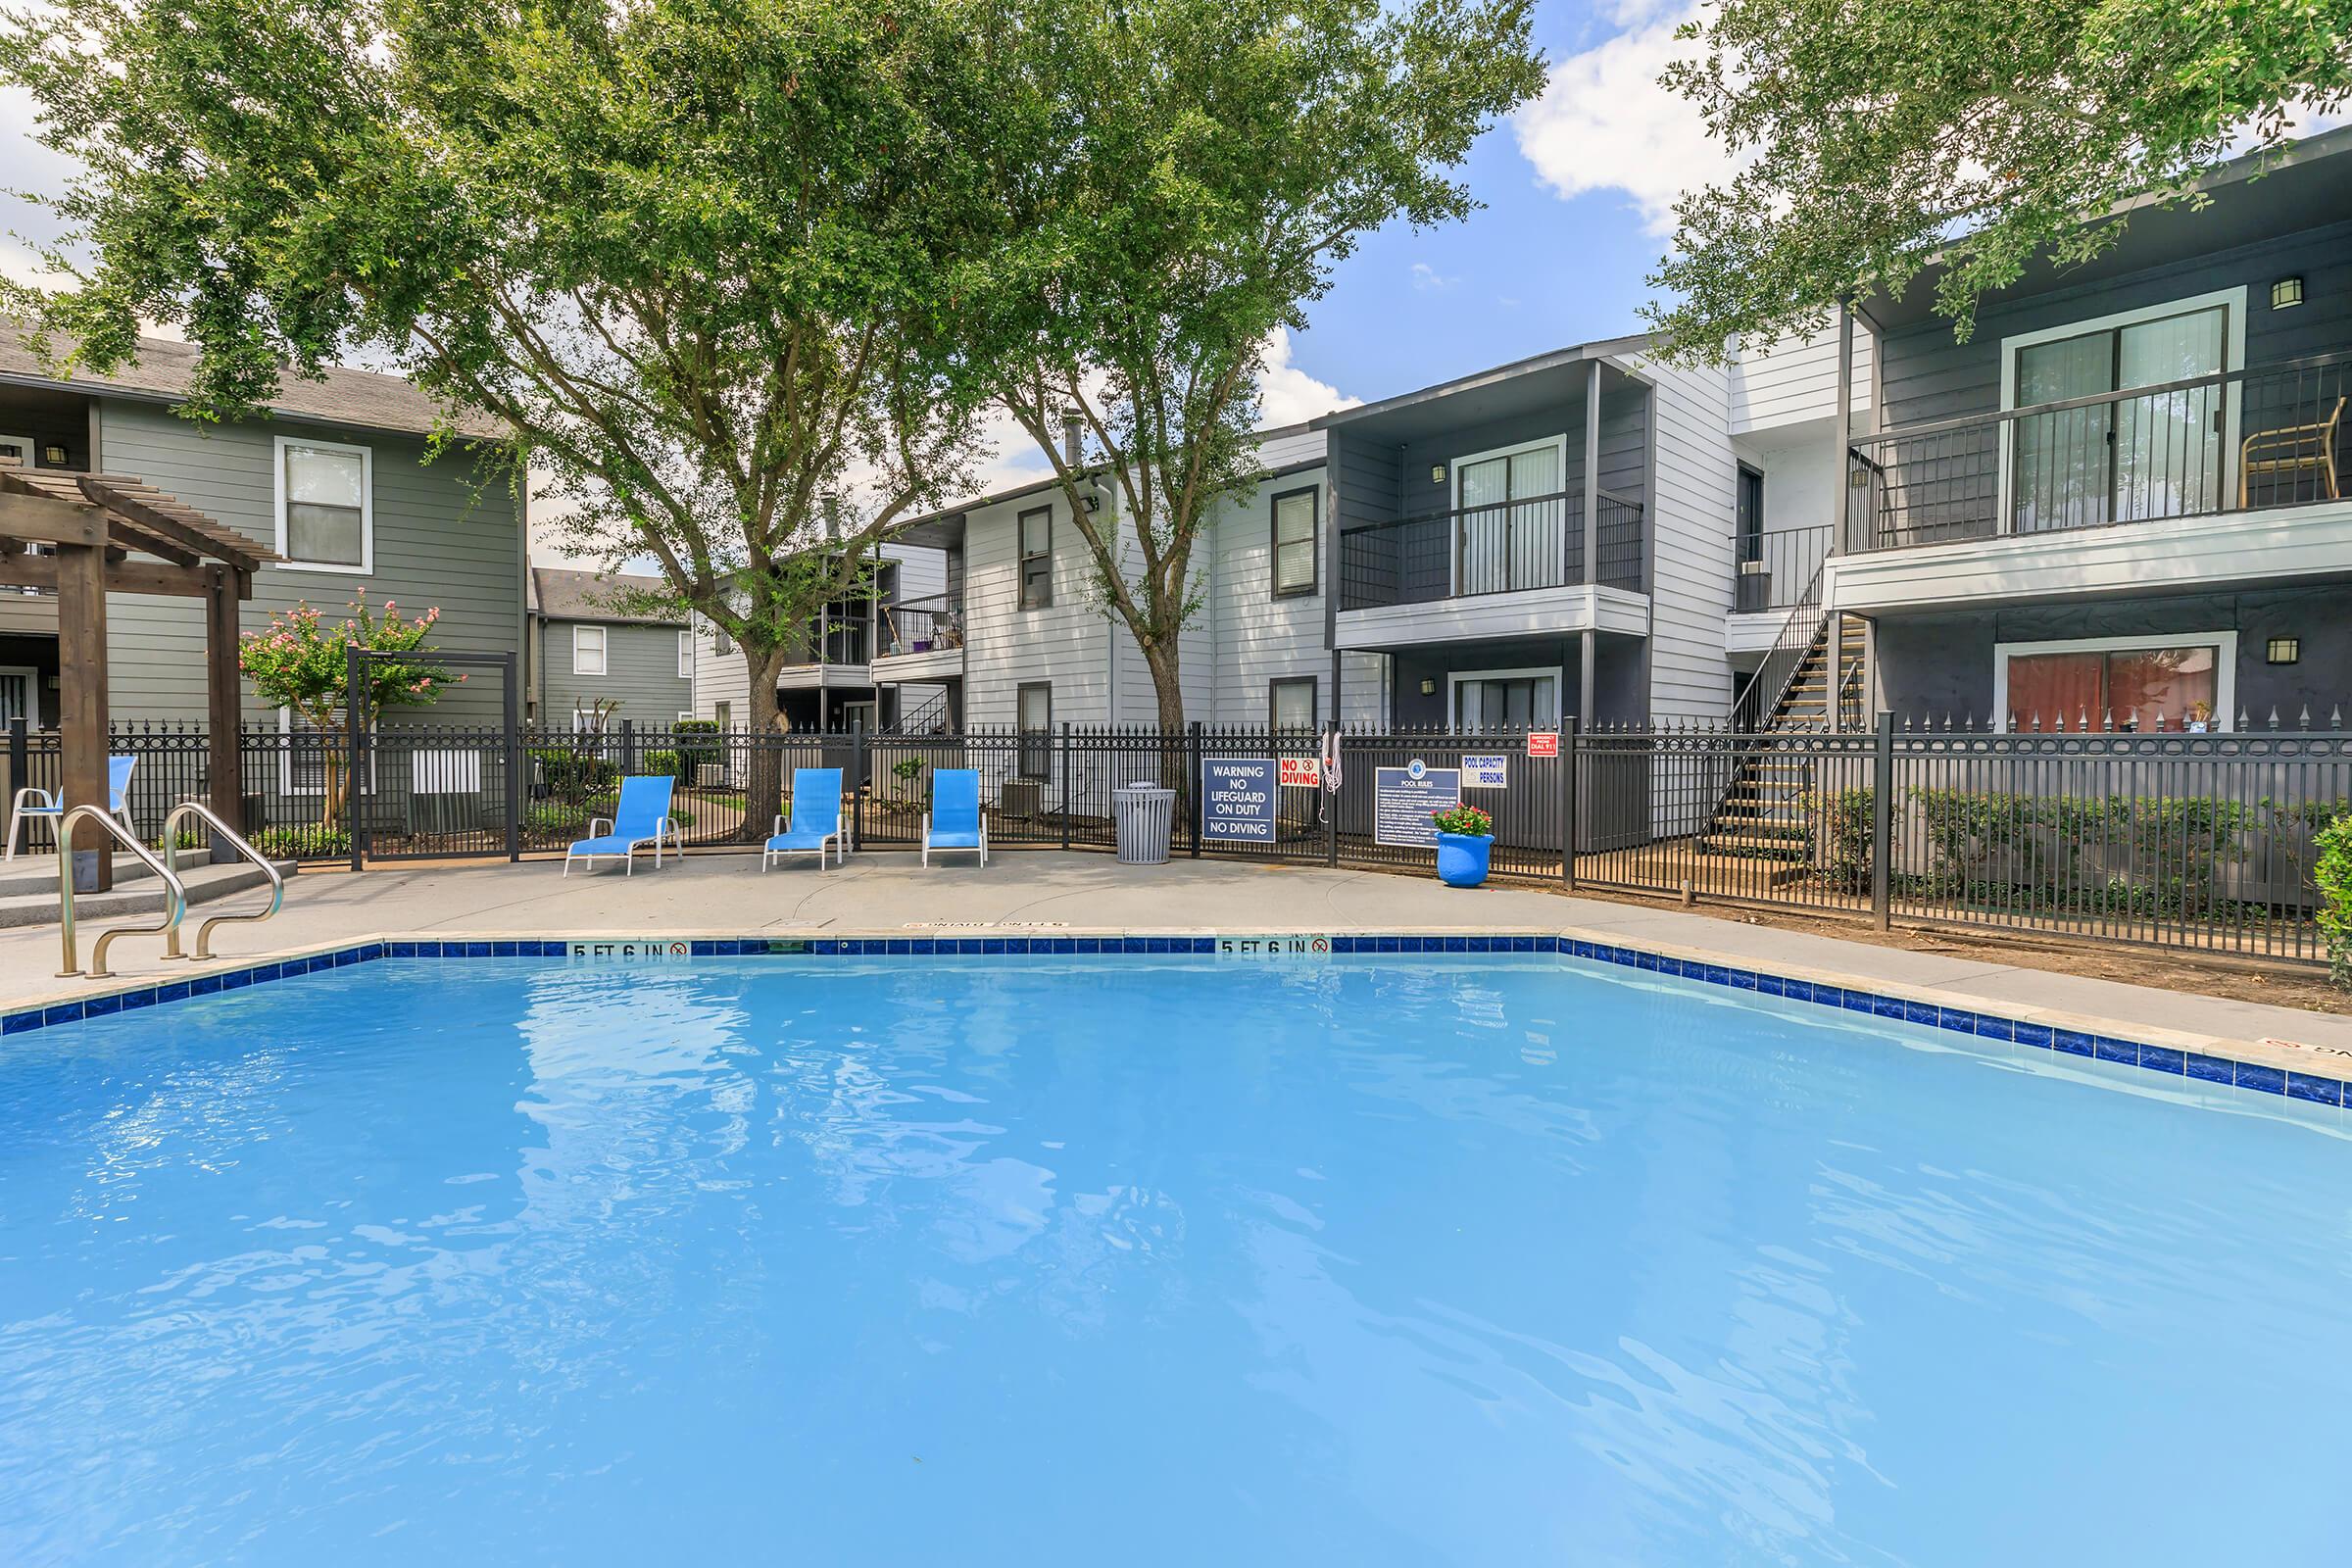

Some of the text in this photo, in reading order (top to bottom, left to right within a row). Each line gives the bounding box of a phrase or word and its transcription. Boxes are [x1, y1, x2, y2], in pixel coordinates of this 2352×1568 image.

[1282, 760, 1298, 771] NO
[1464, 757, 1504, 768] POOL CAPACITY
[1213, 765, 1264, 777] WARNING
[1282, 771, 1318, 785] DIVING
[1480, 771, 1504, 784] PERSONS
[1230, 779, 1247, 790] NO
[1211, 791, 1265, 803] LIFEGUARD
[1216, 804, 1261, 815] ON DUTY
[1210, 822, 1267, 835] NO DIVING
[574, 945, 662, 956] 5 FT 6 IN
[1222, 940, 1304, 953] 5 FT 6 IN
